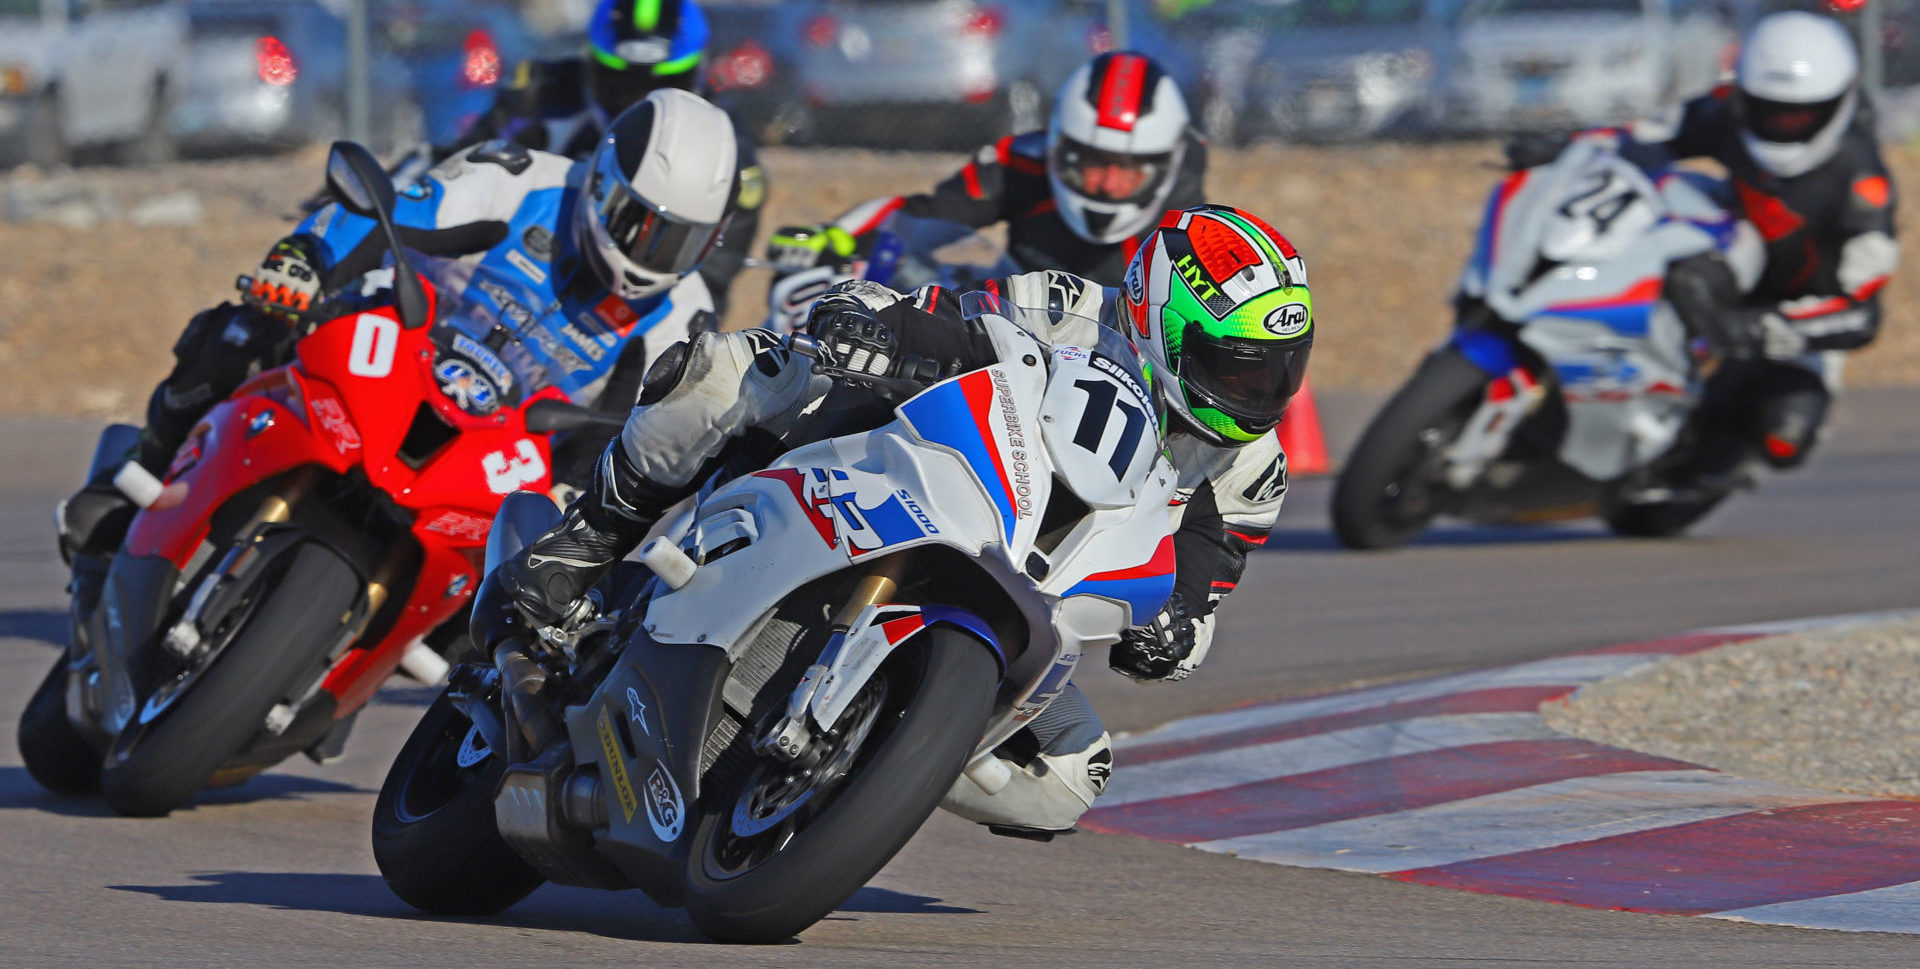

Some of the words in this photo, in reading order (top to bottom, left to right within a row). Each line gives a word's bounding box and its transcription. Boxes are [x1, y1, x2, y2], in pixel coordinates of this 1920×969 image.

[1558, 168, 1640, 234] 24
[1176, 254, 1221, 301] HYT
[348, 313, 400, 378] 0
[1267, 308, 1306, 329] Arai
[1054, 349, 1088, 359] FUCHS
[991, 368, 1026, 448] SUPERBIKE
[1011, 449, 1033, 520] SCHOOL
[1072, 379, 1147, 483] 11
[482, 438, 546, 494] 3
[897, 488, 940, 534] S1000
[602, 730, 634, 813] DUNLOP
[648, 774, 679, 824] R&G
